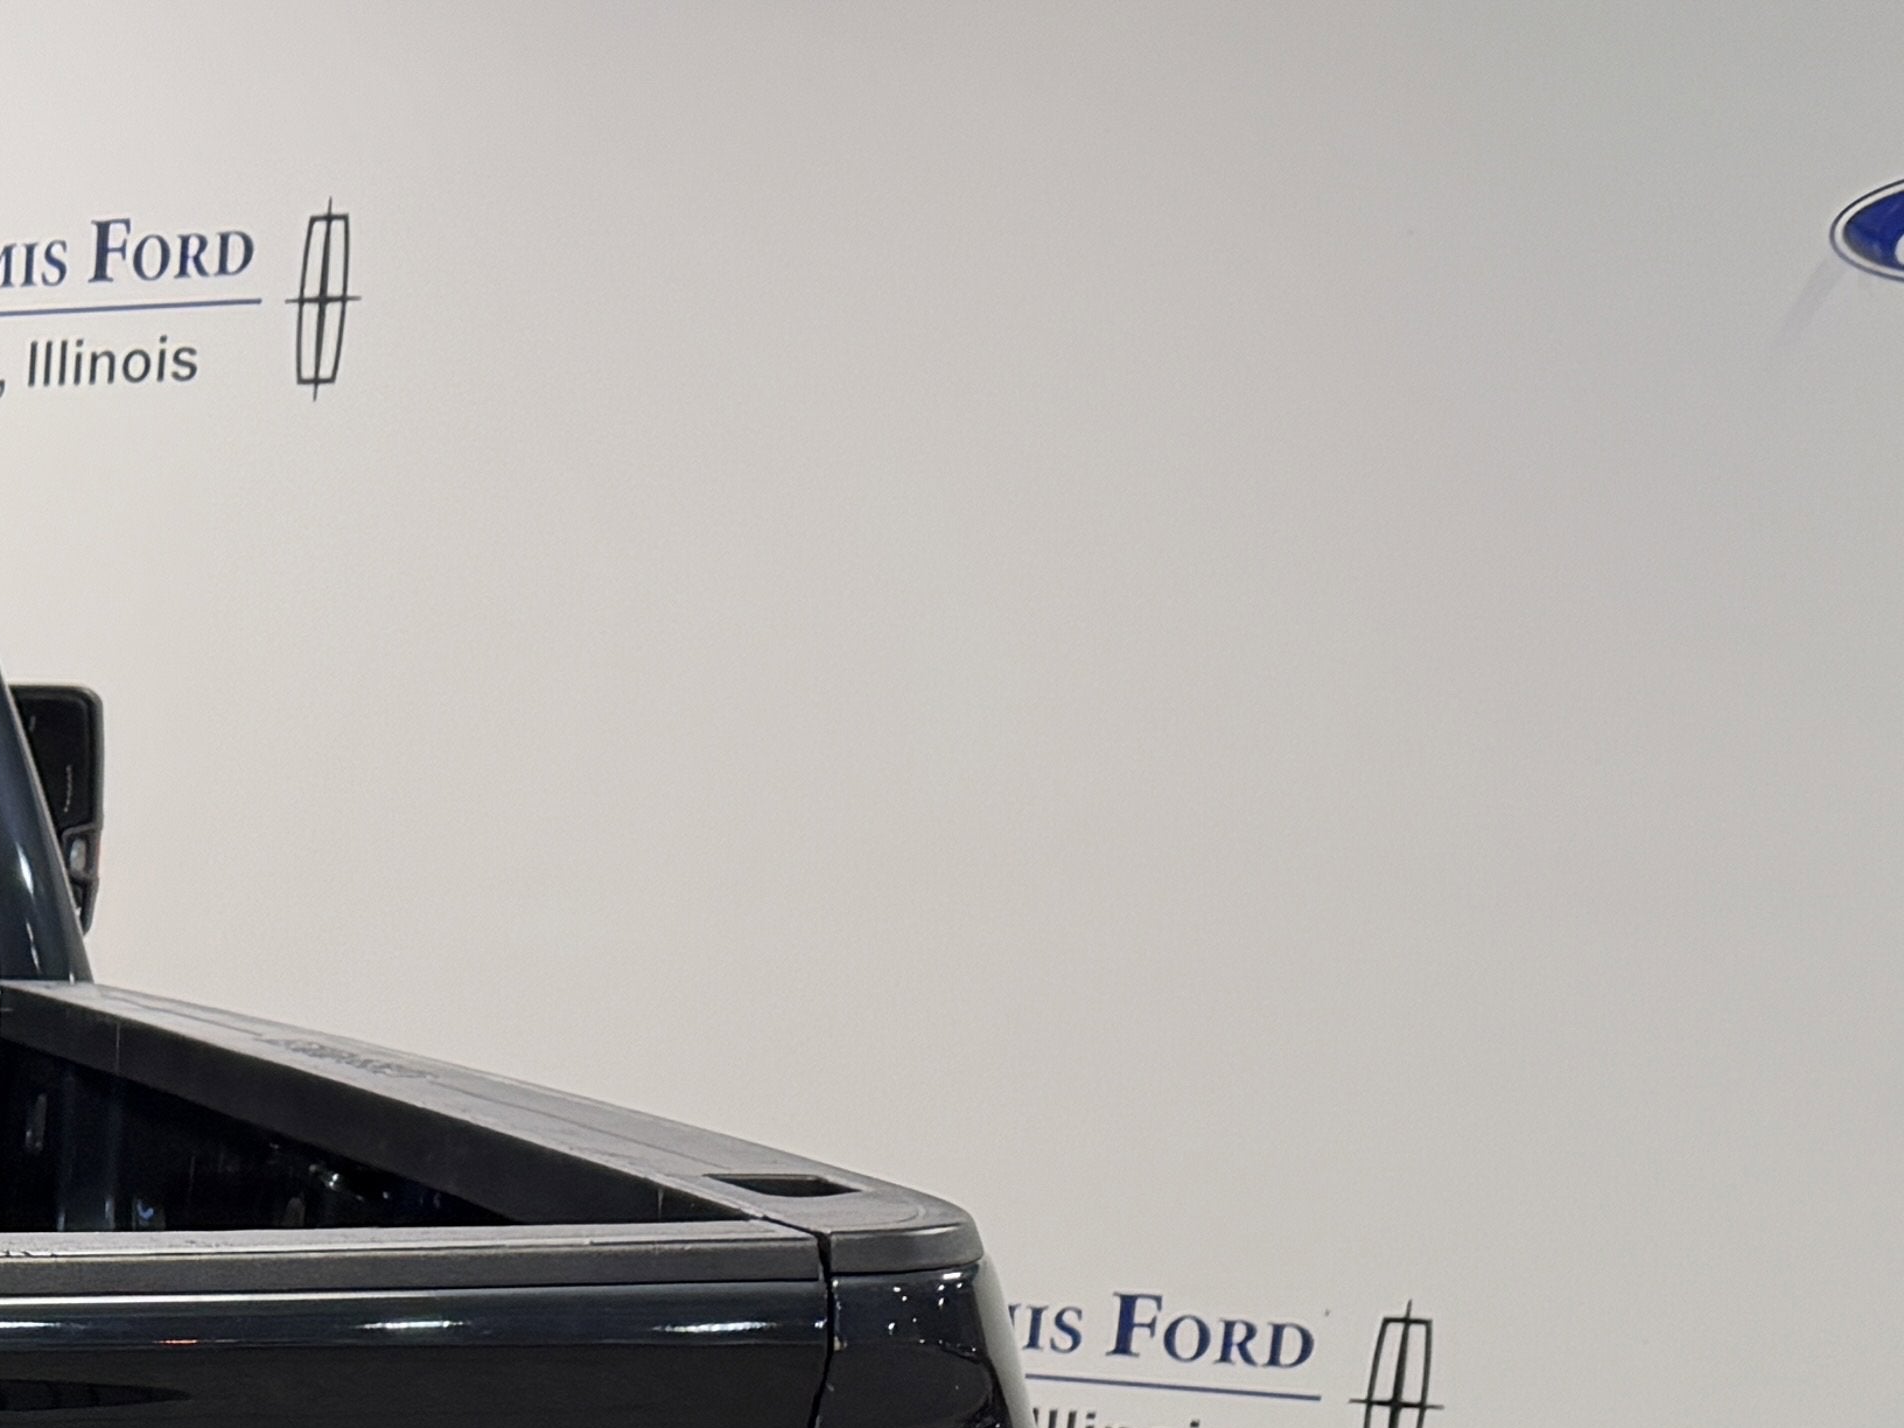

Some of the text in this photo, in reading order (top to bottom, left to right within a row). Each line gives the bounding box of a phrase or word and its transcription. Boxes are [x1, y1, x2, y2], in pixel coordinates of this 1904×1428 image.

[88, 218, 255, 284] FORD
[27, 334, 198, 387] Illinois
[1105, 1292, 1315, 1369] FORD
